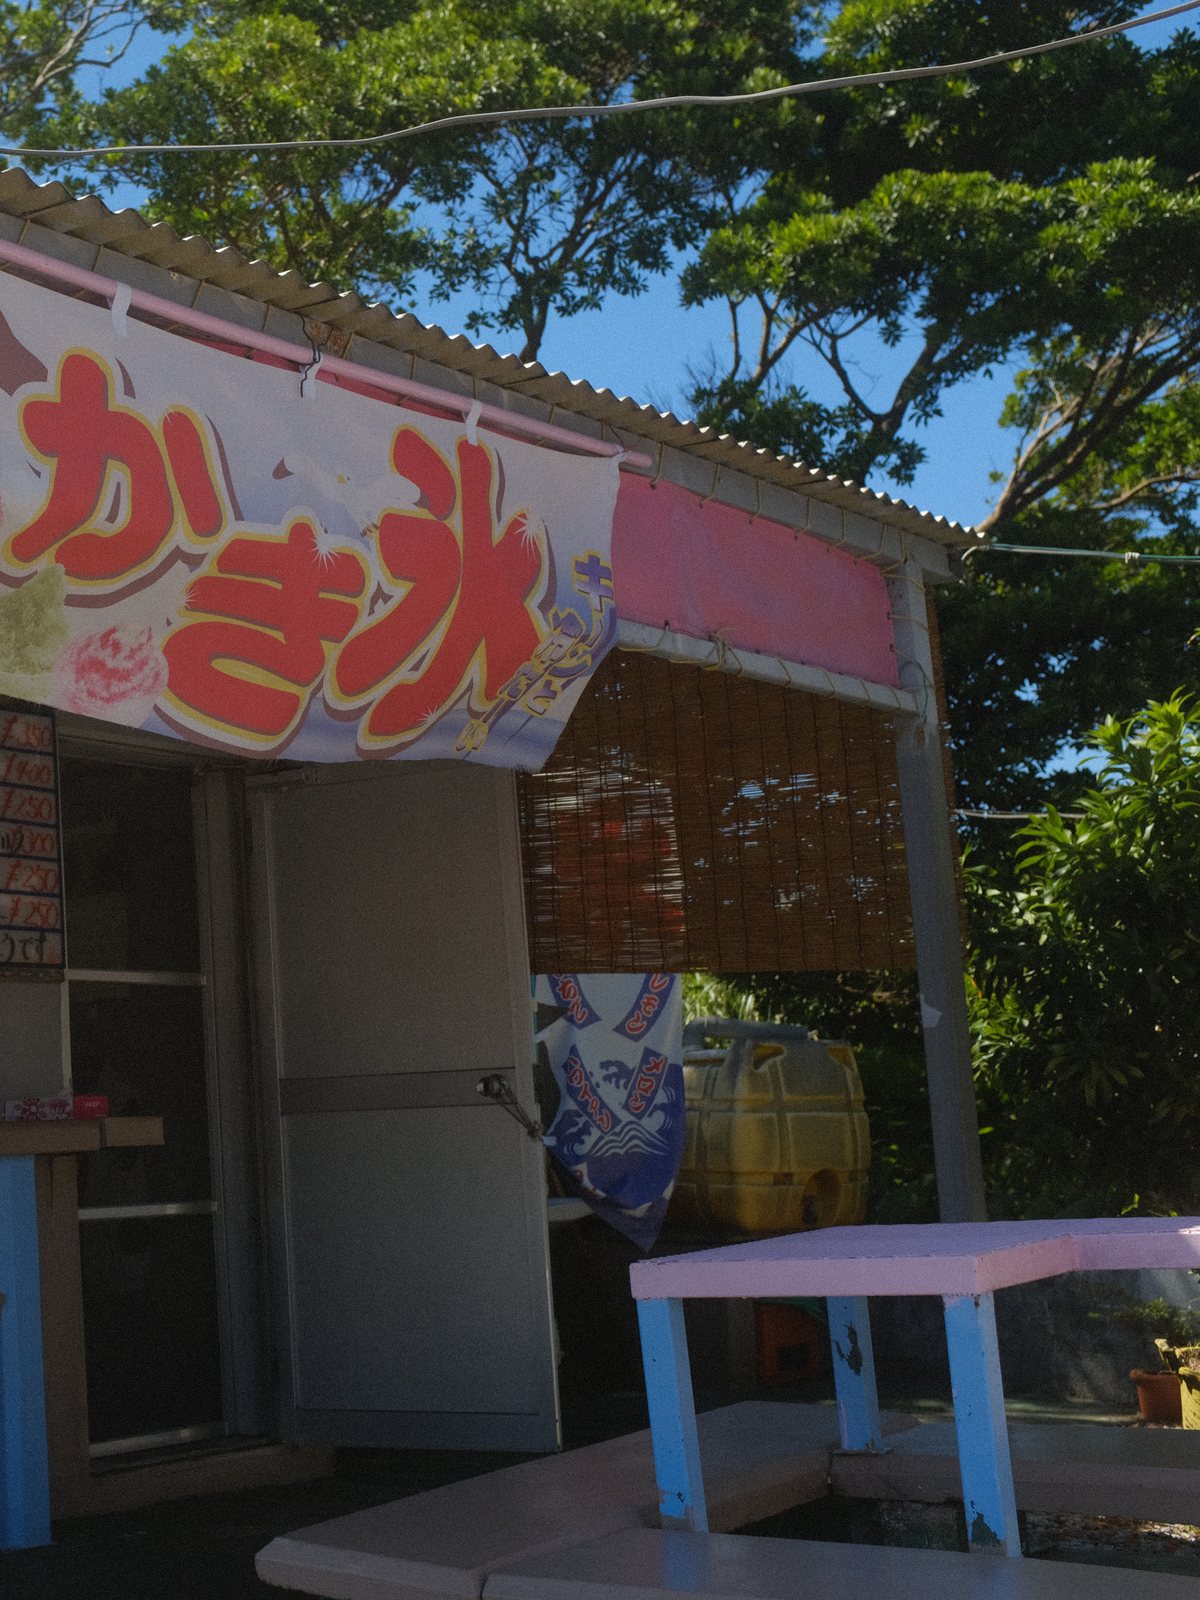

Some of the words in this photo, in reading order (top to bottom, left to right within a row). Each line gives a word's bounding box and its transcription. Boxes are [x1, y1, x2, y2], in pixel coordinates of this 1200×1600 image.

[5, 348, 548, 743] かき氷
[625, 973, 670, 1034] レモン
[628, 1055, 666, 1114] メロン
